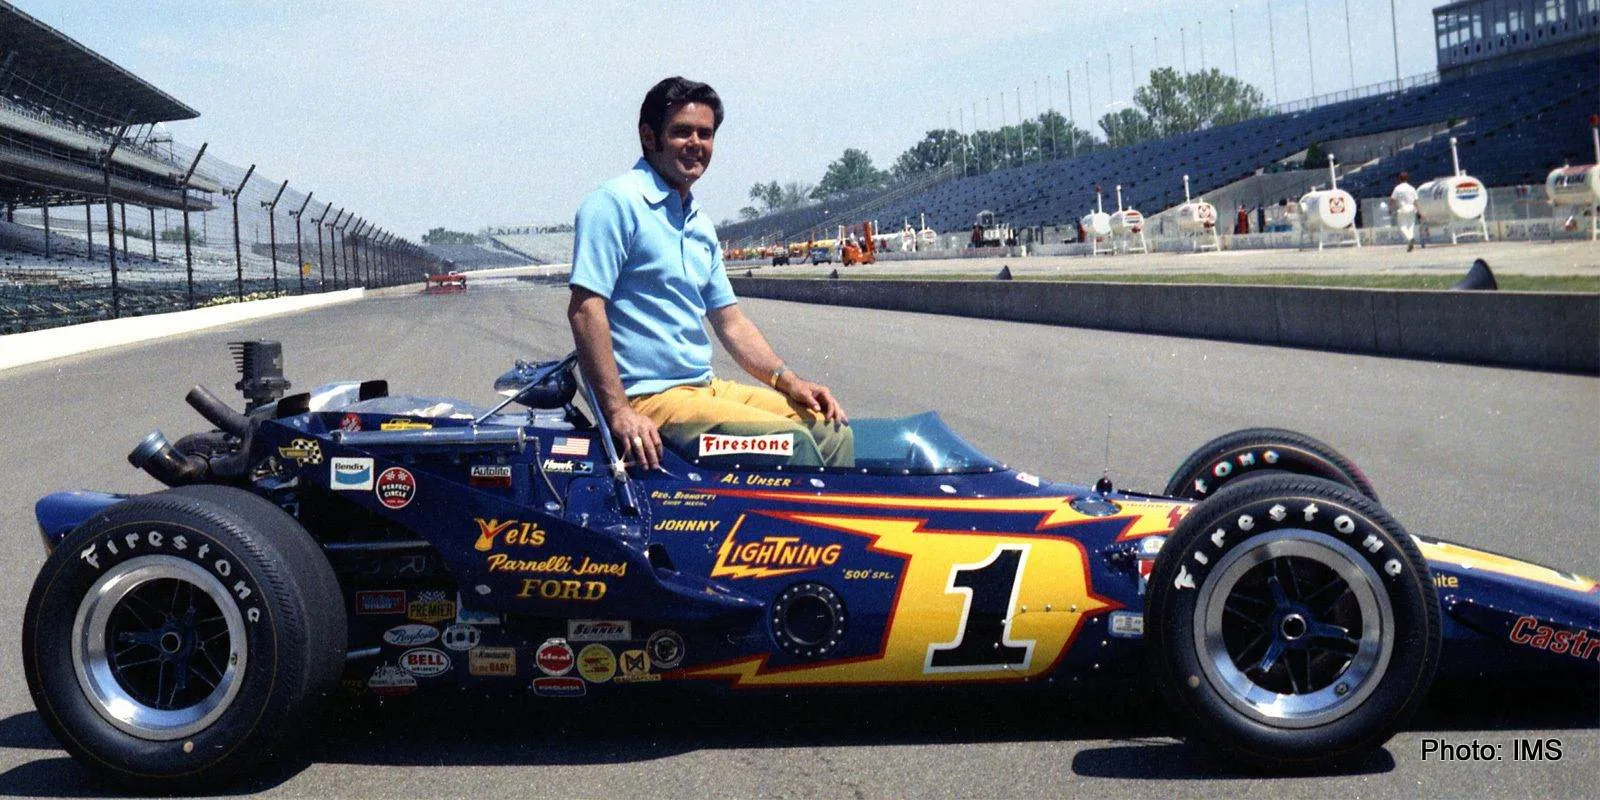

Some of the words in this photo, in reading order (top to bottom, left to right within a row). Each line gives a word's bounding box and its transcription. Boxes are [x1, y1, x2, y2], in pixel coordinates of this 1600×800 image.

[703, 433, 790, 451] Firestone
[335, 462, 365, 471] Bendix
[382, 483, 411, 492] PERFECT
[720, 473, 740, 485] AL
[747, 474, 792, 488] UNSER
[384, 490, 407, 499] CIRCLE
[654, 519, 720, 532] JOHNNY
[710, 513, 842, 579] LIGHTNING
[1174, 503, 1402, 590] Firestone
[487, 554, 571, 575] Parnelli
[572, 556, 628, 577] Jones
[80, 530, 261, 623] Firestone
[518, 579, 608, 600] FORD
[410, 602, 453, 617] PREMIER
[923, 542, 1036, 674] 1
[1509, 615, 1600, 663] Castr
[408, 654, 444, 665] BELL
